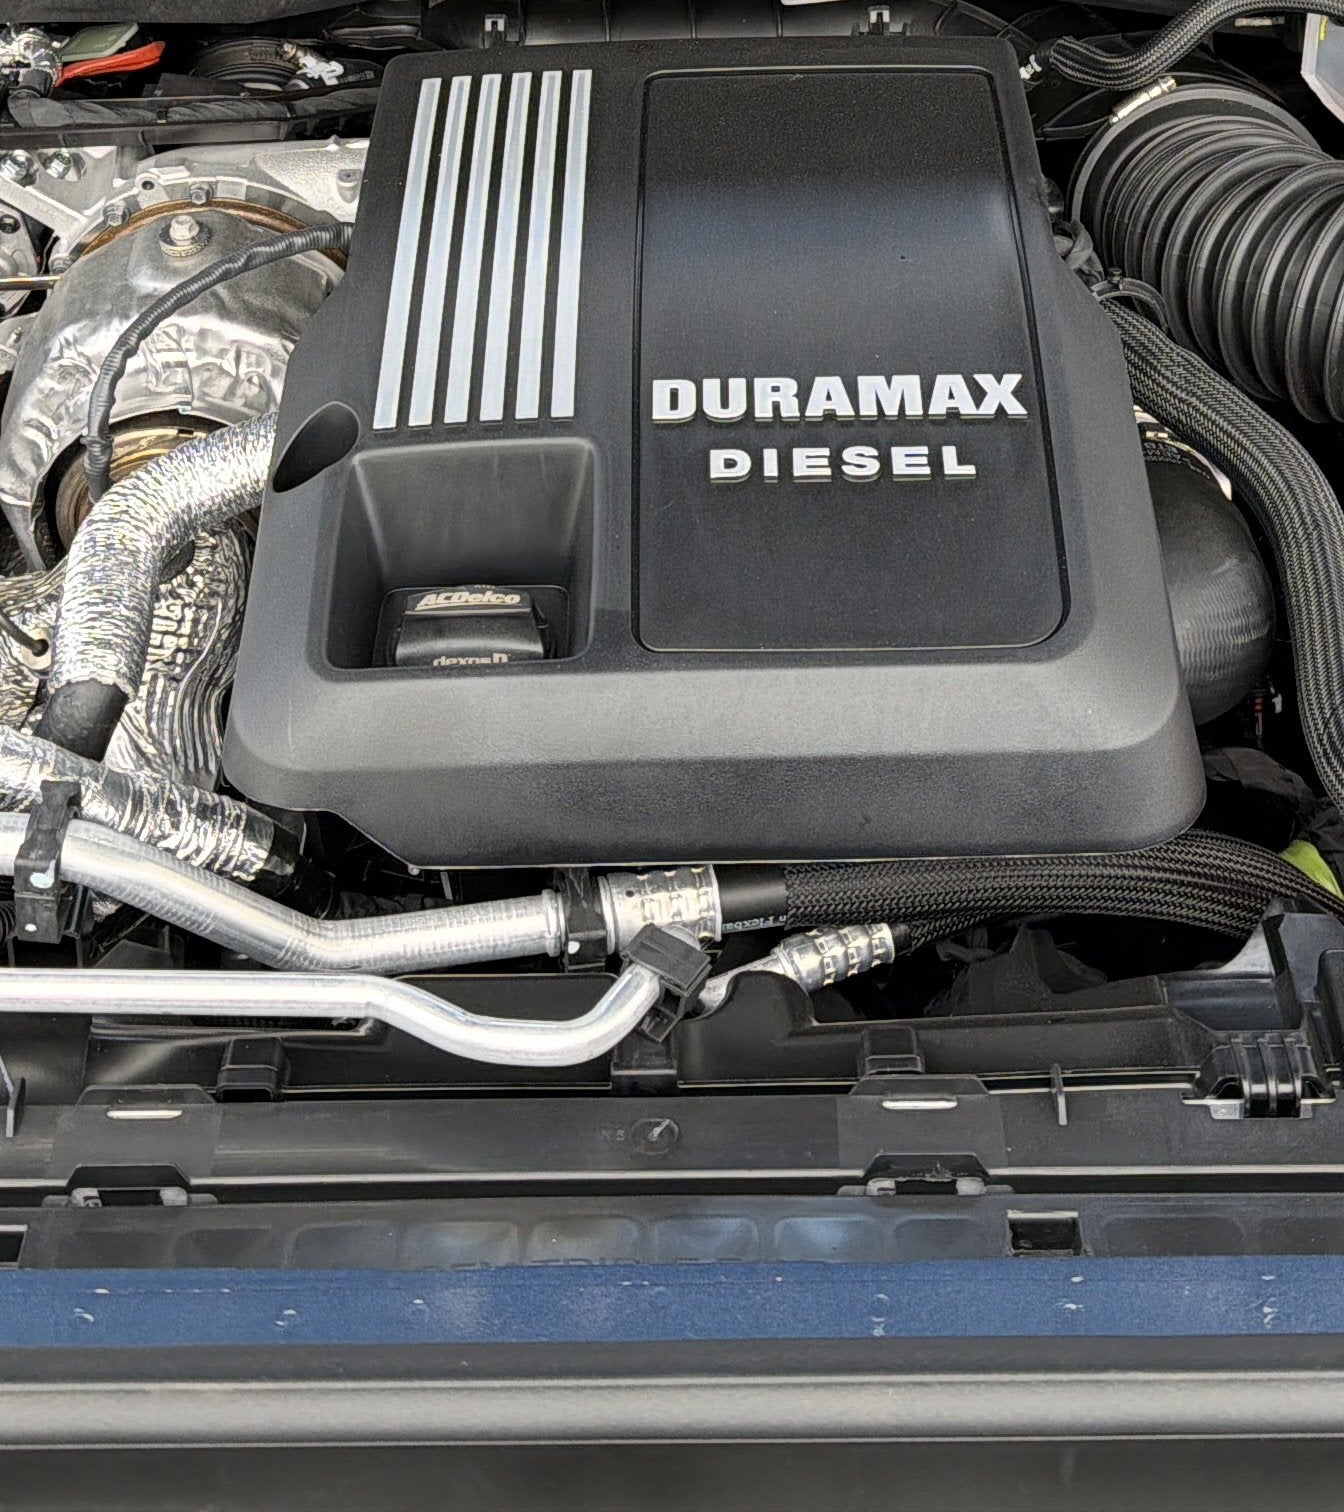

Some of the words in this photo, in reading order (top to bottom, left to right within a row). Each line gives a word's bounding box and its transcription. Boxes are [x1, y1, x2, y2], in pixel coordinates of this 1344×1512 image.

[650, 372, 1029, 423] DURAMAX
[708, 444, 978, 482] DIESEL
[415, 590, 522, 610] ACDelco
